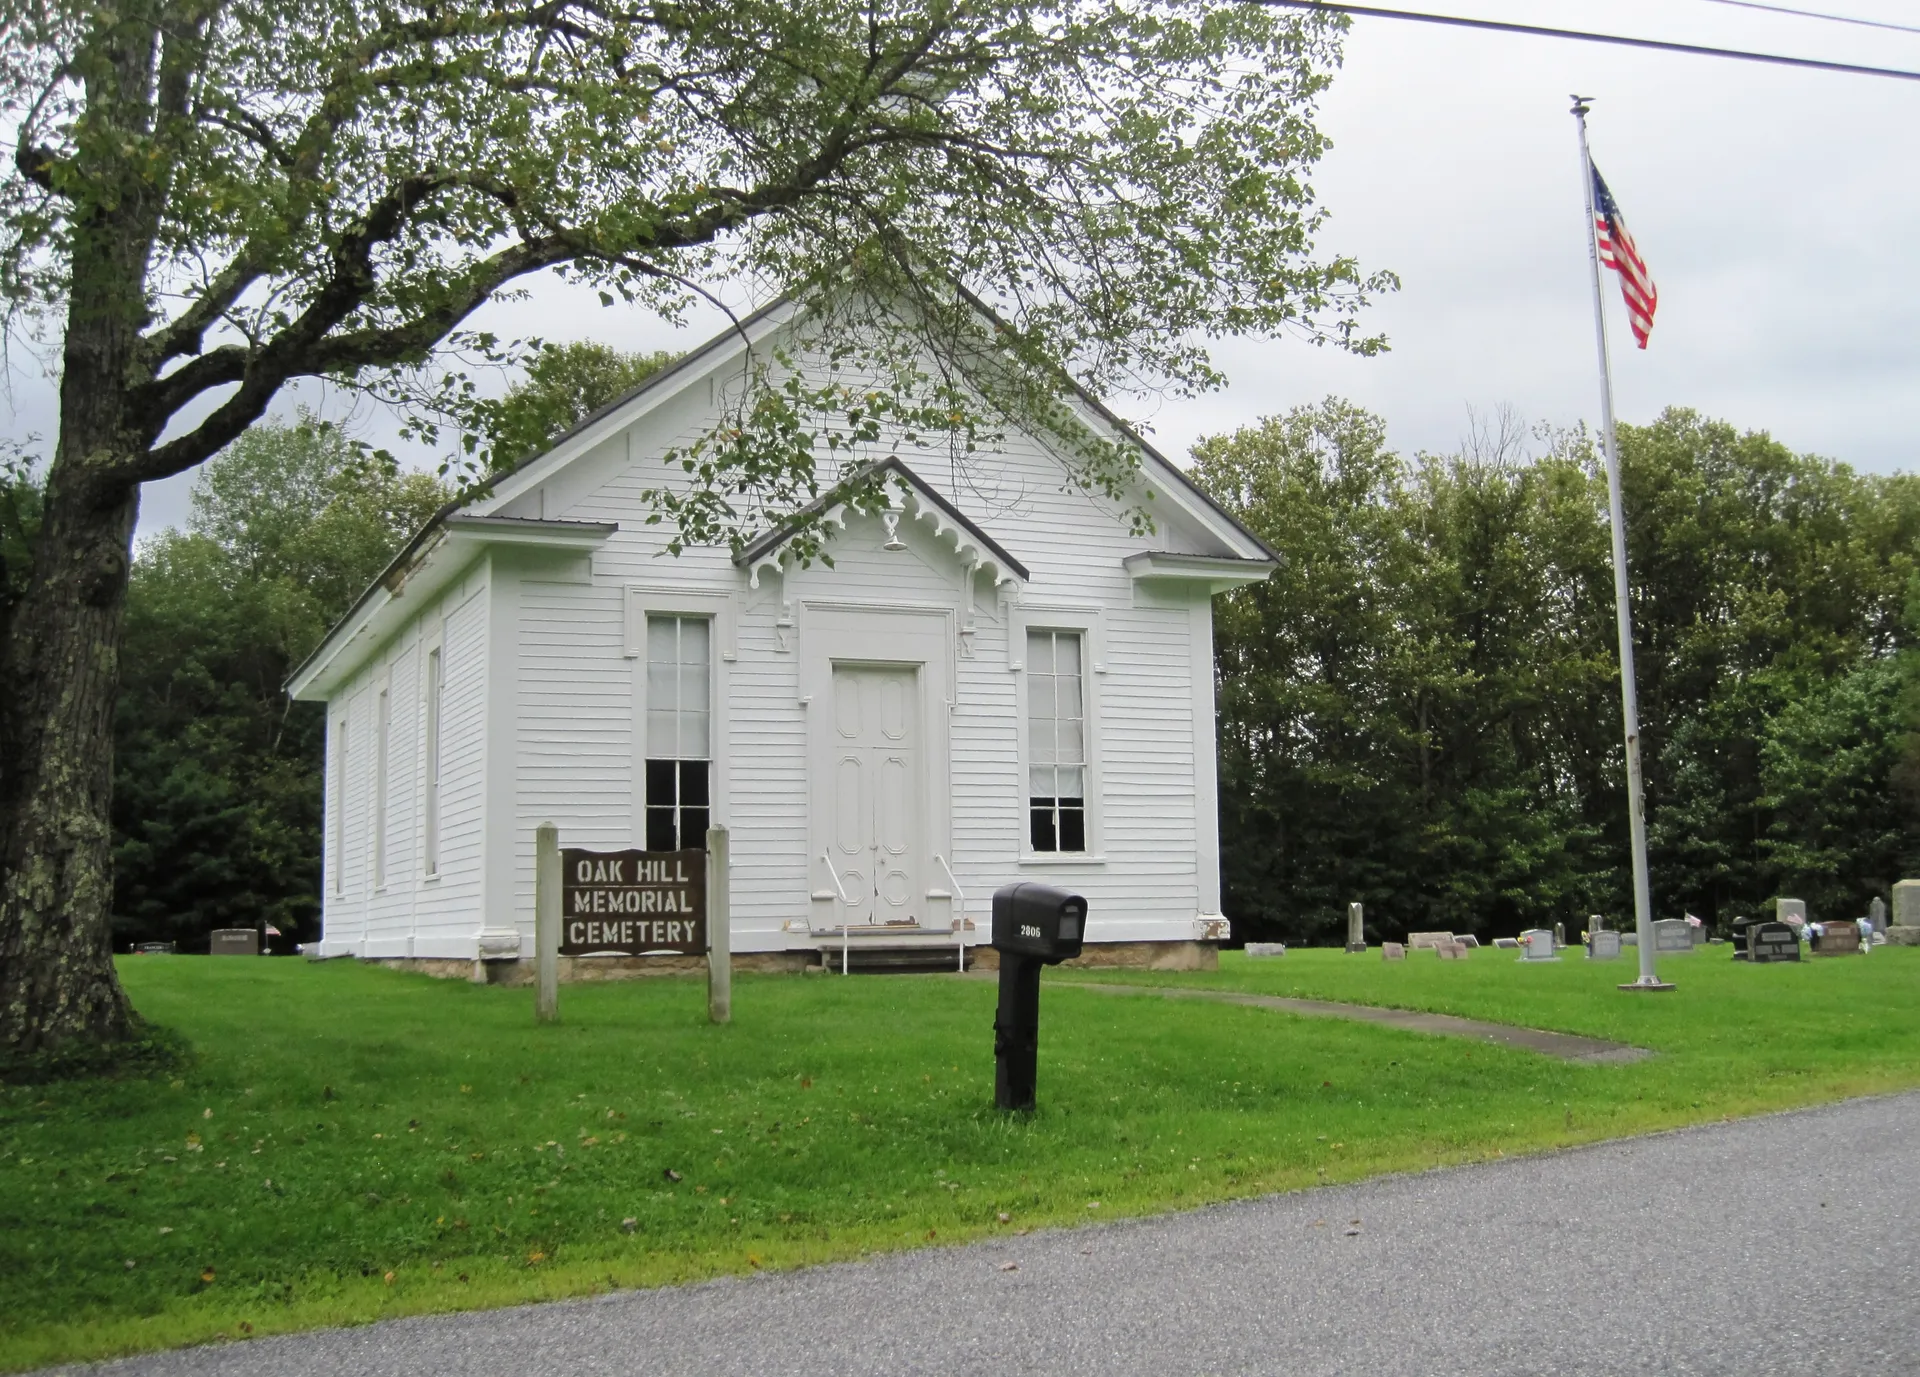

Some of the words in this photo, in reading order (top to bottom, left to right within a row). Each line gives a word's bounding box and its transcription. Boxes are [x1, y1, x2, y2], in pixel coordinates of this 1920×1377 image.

[577, 860, 623, 882] OAK
[637, 860, 689, 882] HILL
[574, 890, 693, 913] MEMORIAL
[570, 920, 696, 944] CEMETERY
[1020, 924, 1041, 938] 2806
